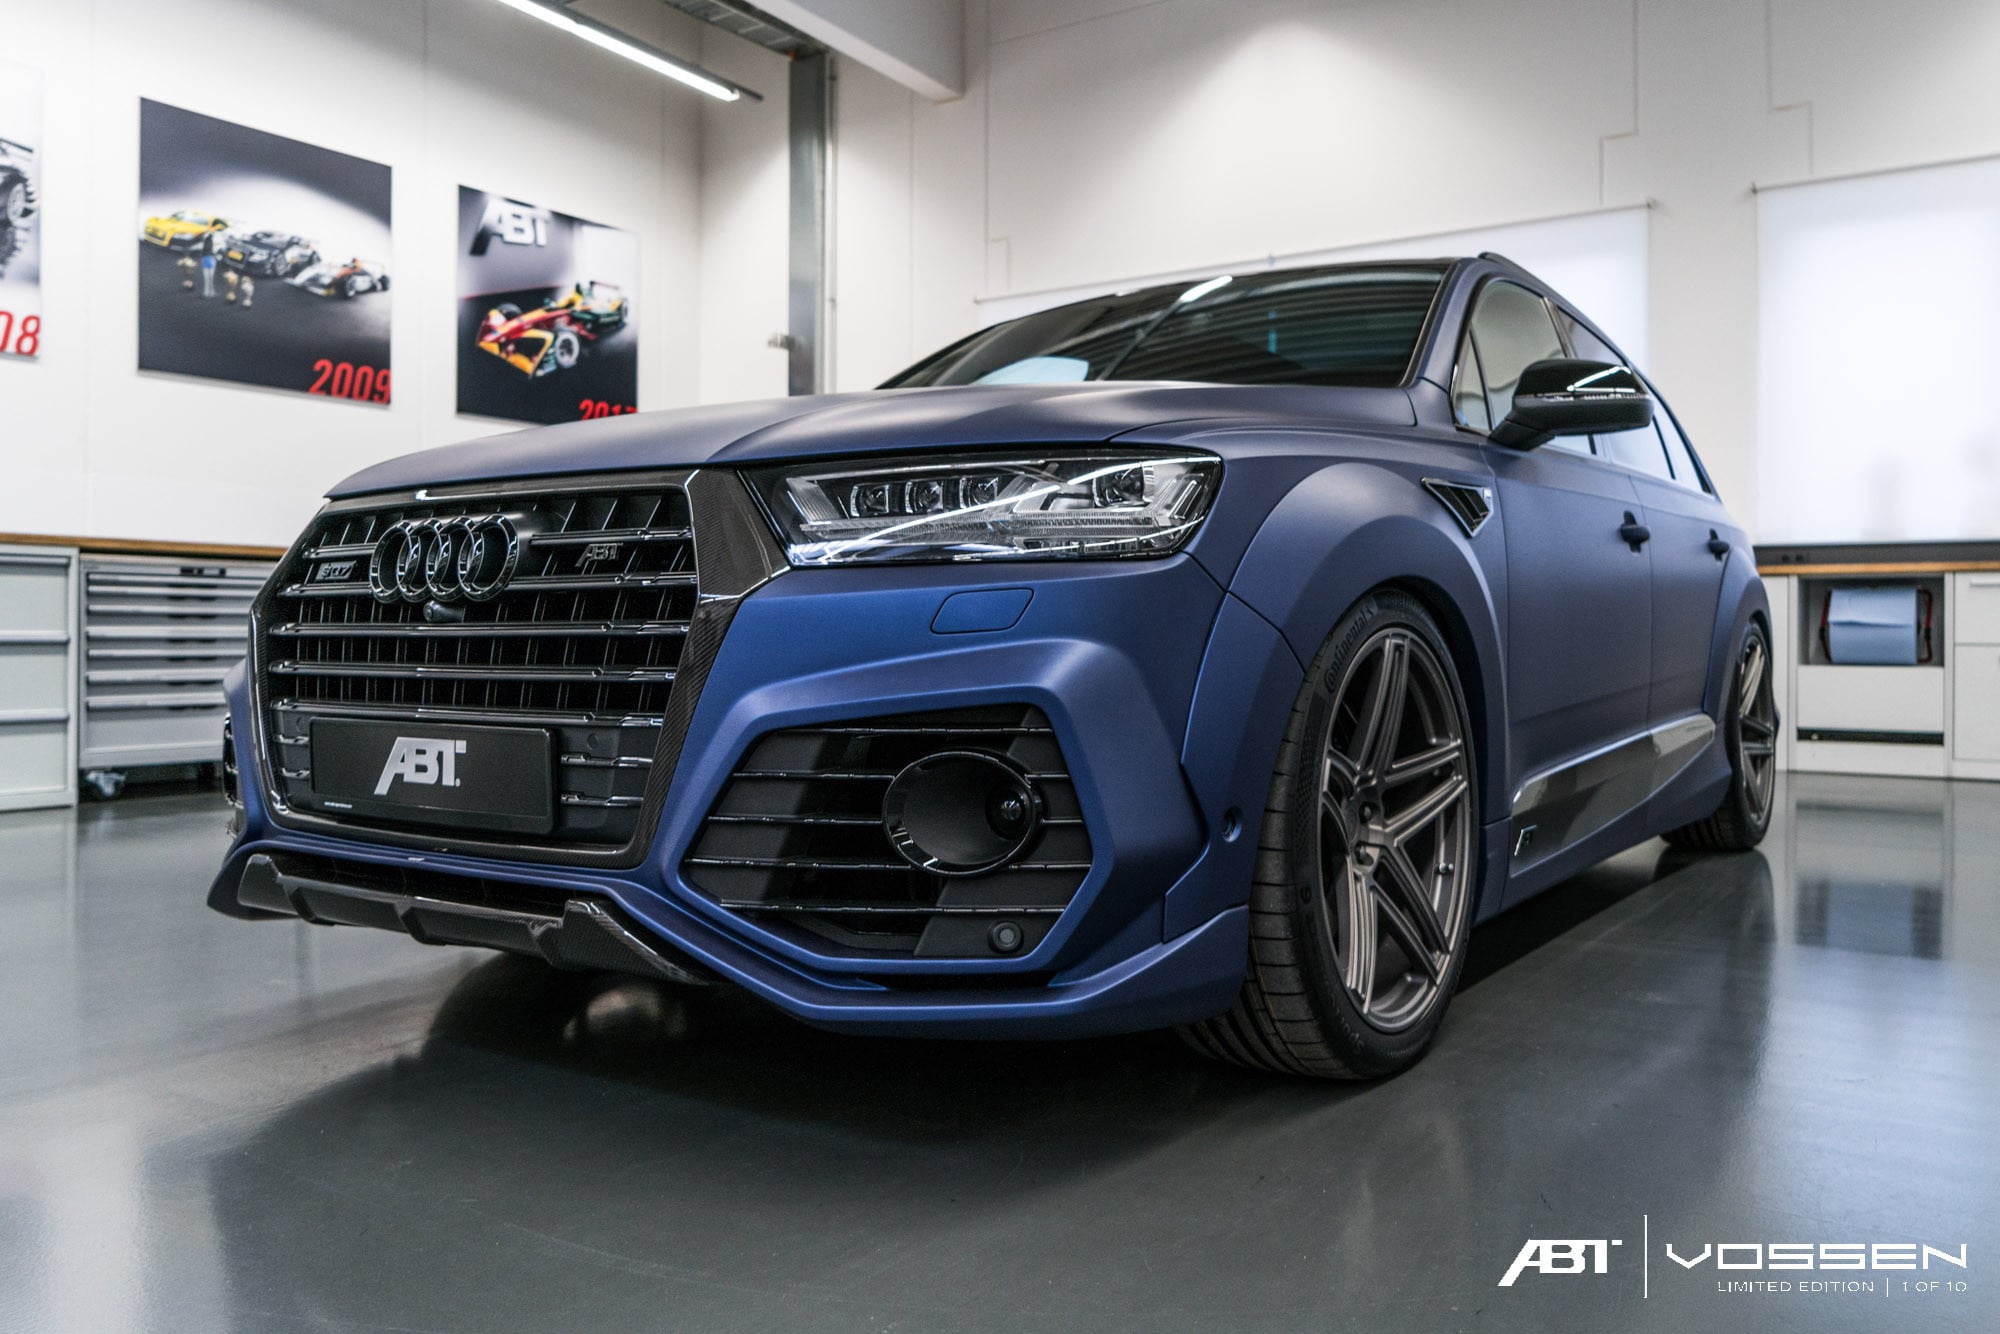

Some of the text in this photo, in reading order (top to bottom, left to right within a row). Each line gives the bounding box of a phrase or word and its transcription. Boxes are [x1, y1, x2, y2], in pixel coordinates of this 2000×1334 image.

[469, 197, 549, 256] ABT
[309, 358, 391, 405] 2009
[579, 398, 638, 420] 20
[575, 543, 623, 567] ABT
[1324, 608, 1369, 694] Continental
